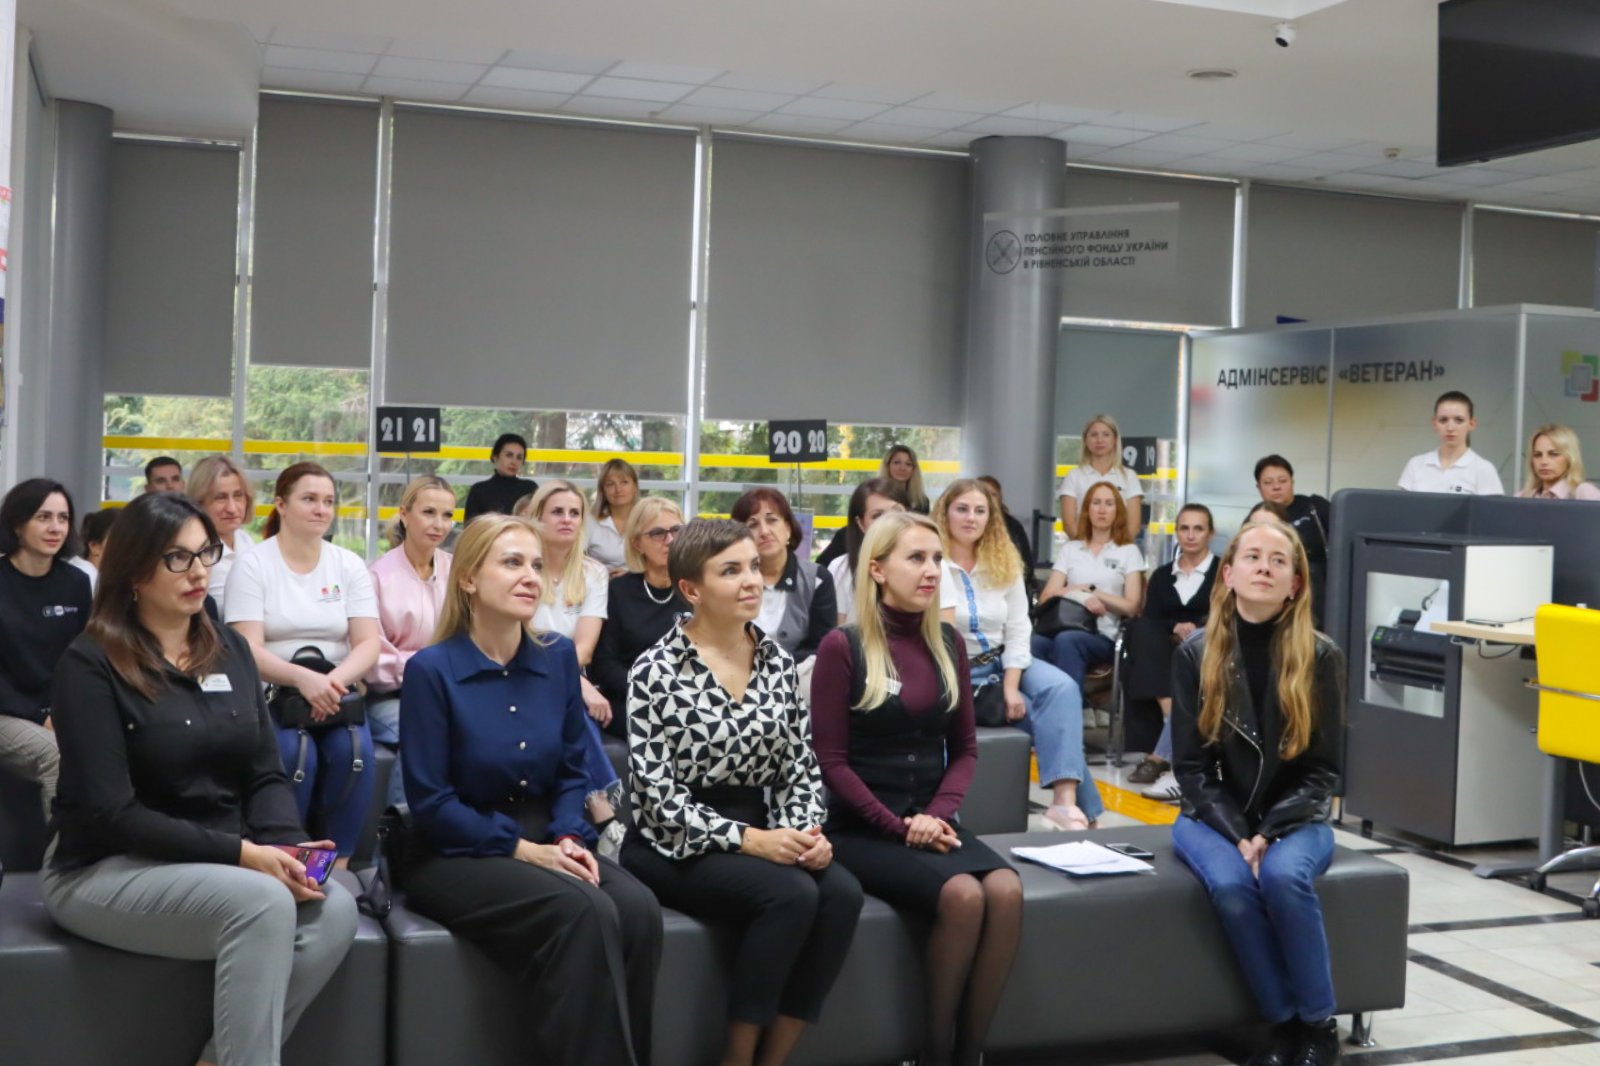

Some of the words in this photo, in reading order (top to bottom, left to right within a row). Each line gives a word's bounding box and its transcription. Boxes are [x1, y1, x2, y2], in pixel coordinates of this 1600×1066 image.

[1024, 232, 1068, 243] ГОЛОВНЕ
[1070, 229, 1130, 241] УПРАВЛІННЯ
[1023, 243, 1085, 256] ПЕНСІЙНОГО
[1087, 242, 1123, 254] ФОНДУ
[1126, 240, 1168, 252] УКРАЇНИ
[1031, 255, 1090, 269] РІВНЕНСЬКІЙ
[1094, 256, 1135, 267] ОБЛАСТІ
[1217, 365, 1327, 389] АДМІНСЕРВІС
[1338, 360, 1445, 383] «ВЕТЕРАН»
[381, 416, 403, 442] 21
[412, 417, 435, 442] 21
[772, 430, 802, 454] 20
[808, 429, 825, 453] 20
[1123, 446, 1138, 467] 9
[1146, 446, 1156, 467] 19
